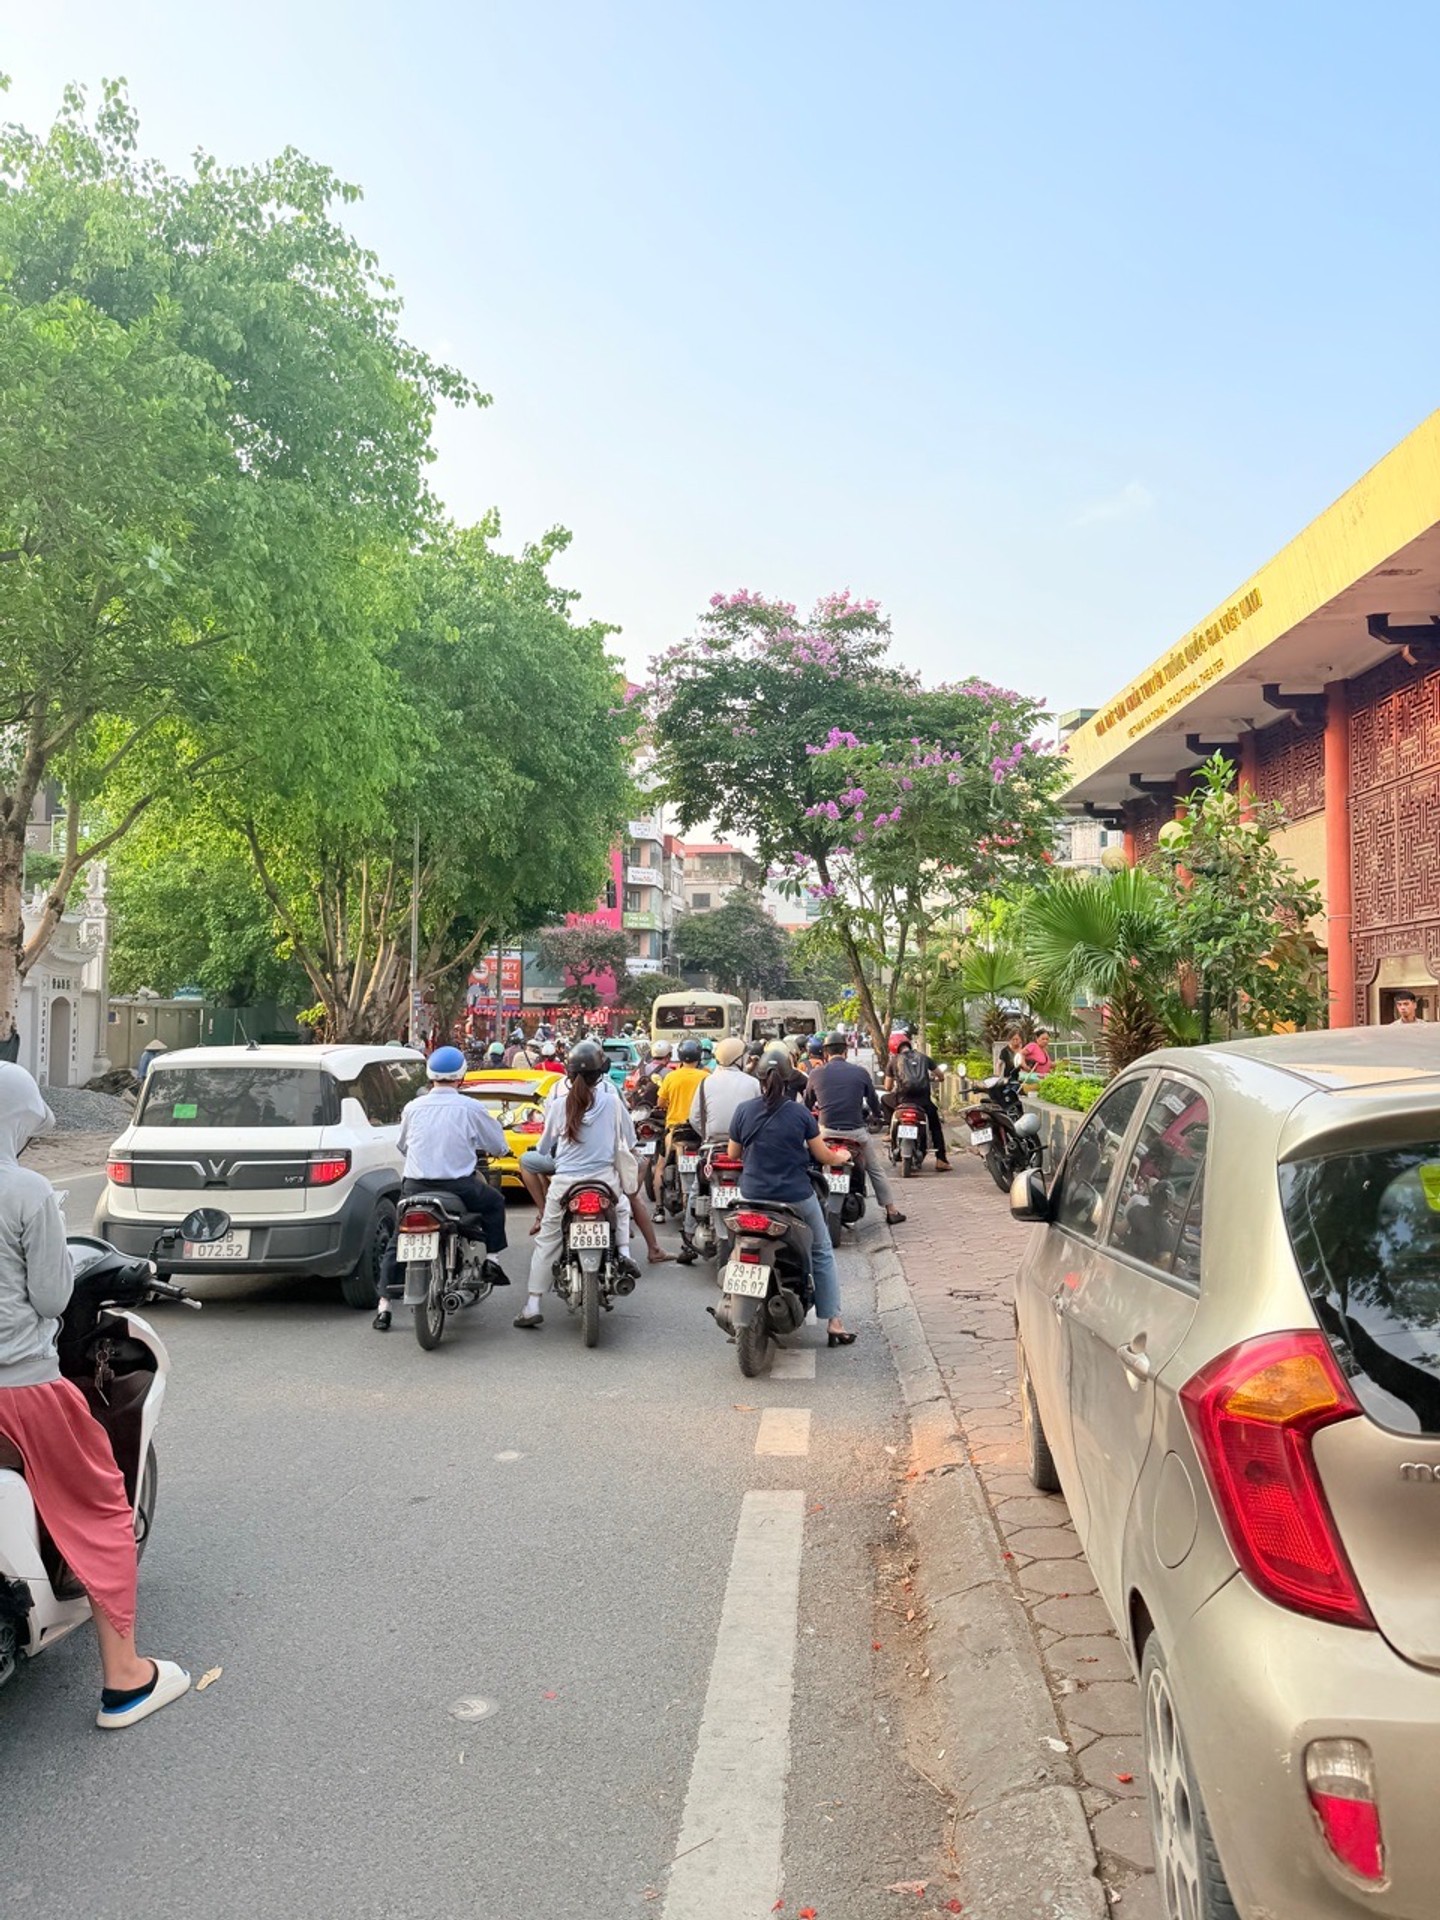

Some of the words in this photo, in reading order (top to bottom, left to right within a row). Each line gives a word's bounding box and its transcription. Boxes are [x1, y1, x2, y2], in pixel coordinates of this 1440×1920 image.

[576, 1224, 604, 1235] 34-C1
[573, 1235, 607, 1247] 269.66
[198, 1243, 243, 1257] 072.52
[403, 1246, 432, 1259] 8122
[732, 1264, 762, 1281] 29-F1
[727, 1278, 764, 1295] 666.07
